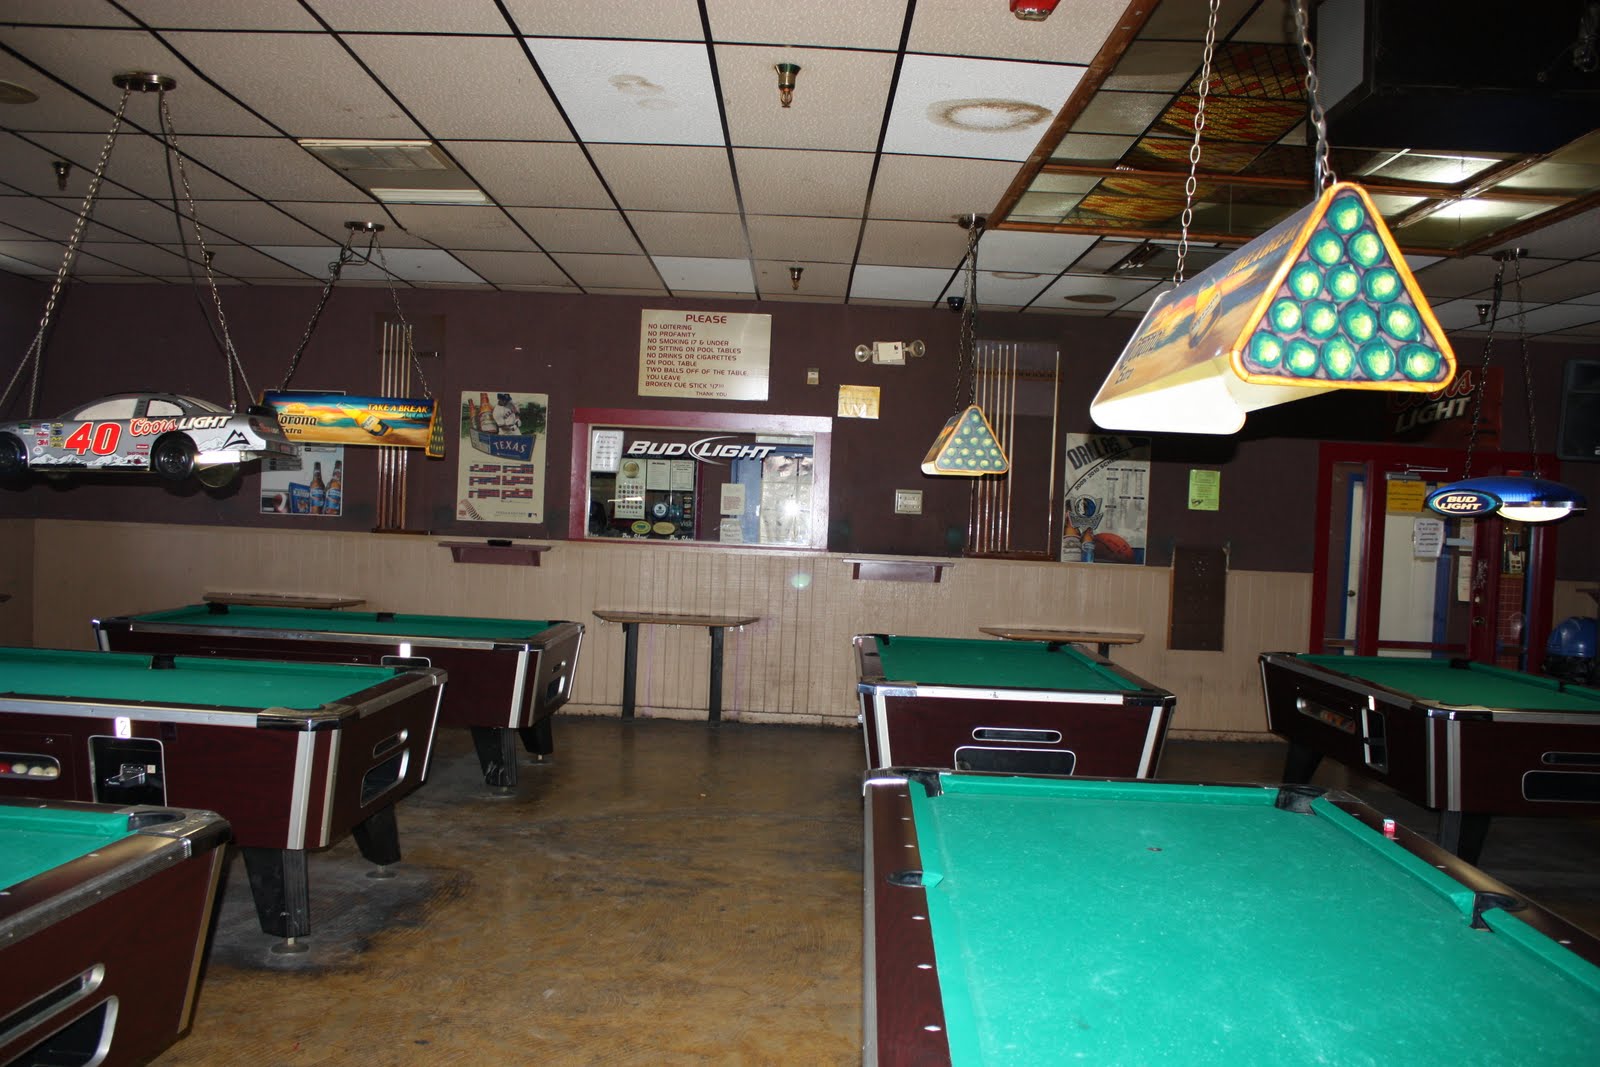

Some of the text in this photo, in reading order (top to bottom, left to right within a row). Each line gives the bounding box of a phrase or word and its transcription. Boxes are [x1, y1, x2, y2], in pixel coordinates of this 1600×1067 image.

[686, 314, 727, 324] PLEASE
[658, 352, 683, 360] DRINKS
[368, 404, 390, 412] TAKE
[398, 405, 429, 413] BREAK
[130, 416, 233, 437] Coors LIGHT
[63, 422, 122, 456] 40
[493, 440, 527, 453] TEXAS
[627, 441, 687, 456] BUD
[698, 443, 777, 459] LIGHT
[1446, 495, 1478, 503] BUD
[1440, 502, 1482, 511] LIGHT
[120, 720, 128, 736] 2
